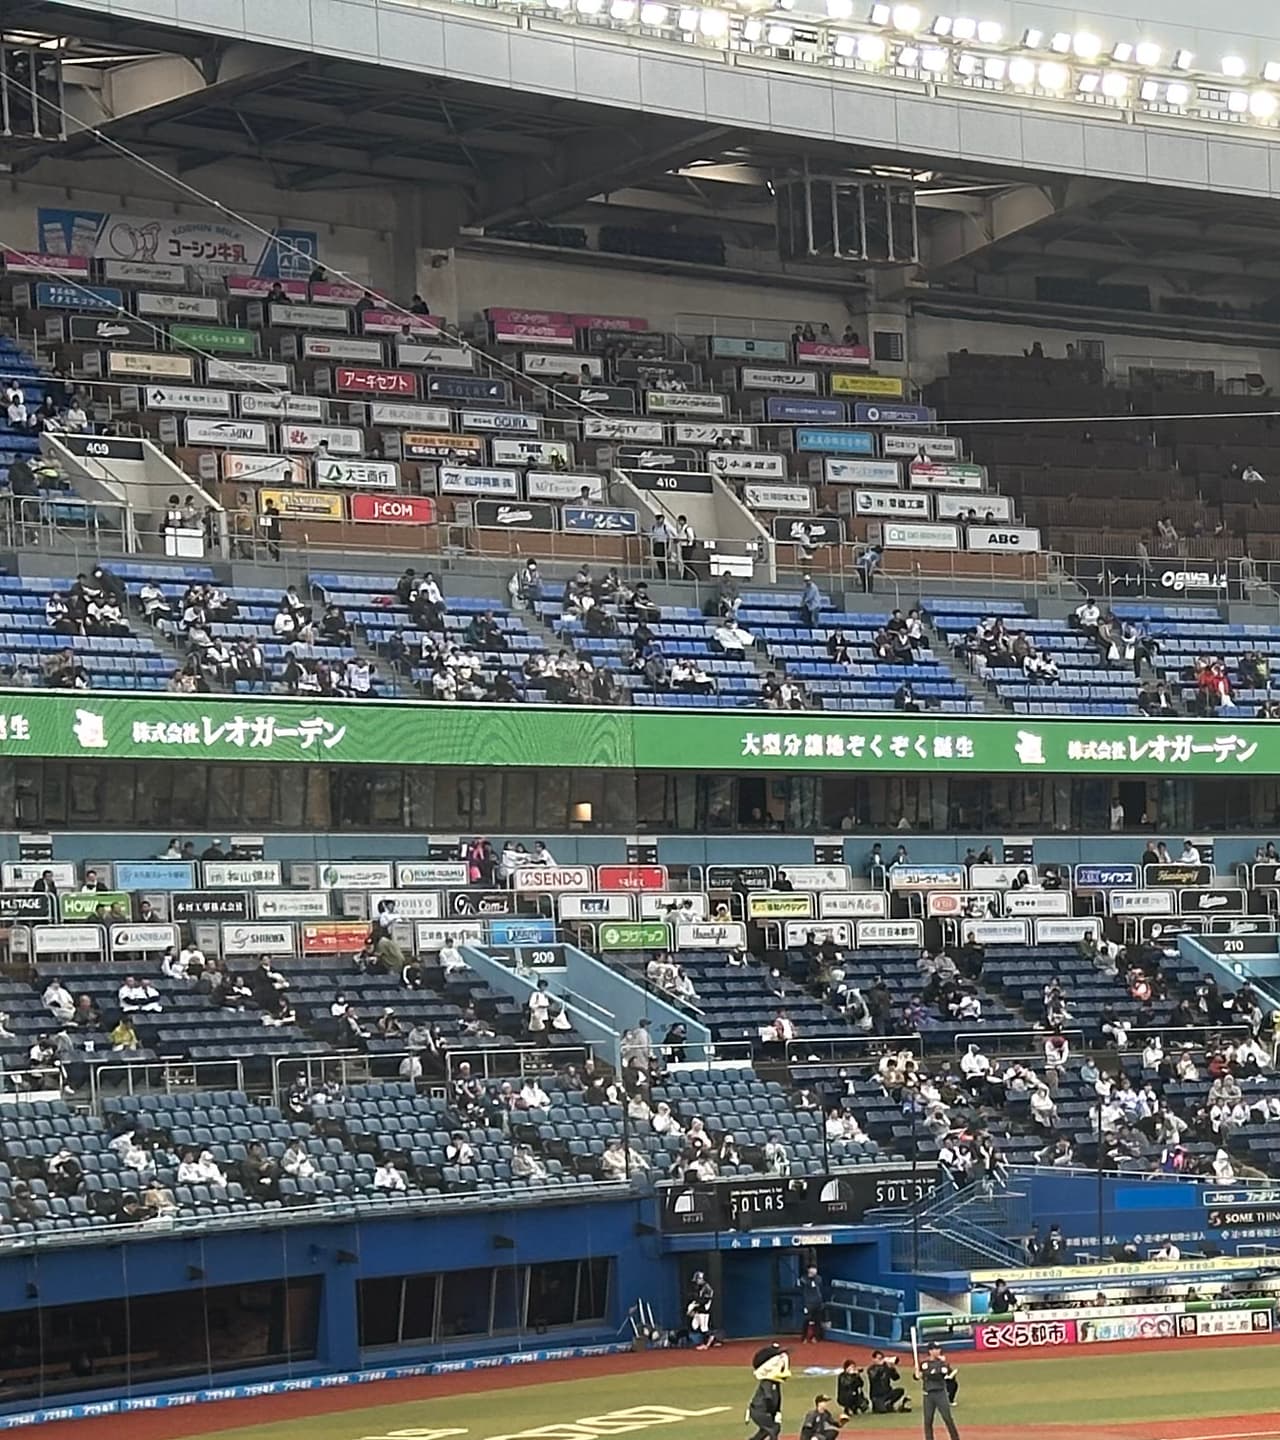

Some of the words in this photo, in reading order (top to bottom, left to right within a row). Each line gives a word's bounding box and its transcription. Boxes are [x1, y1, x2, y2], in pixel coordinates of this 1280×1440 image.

[168, 238, 247, 262] コーシン牛乳
[344, 371, 408, 389] アーキセプト
[86, 443, 109, 455] 409
[656, 477, 677, 488] 410
[373, 502, 413, 516] J:COM
[988, 534, 1020, 545] ABC
[132, 715, 346, 749] 株式会社レオガーデン
[1067, 734, 1258, 763] 株式会社レオガーデン
[536, 871, 583, 886] SENDO
[1224, 940, 1244, 951] 210
[532, 951, 555, 963] 209
[730, 1197, 785, 1214] SOLAS
[1225, 1213, 1254, 1224] SOME
[982, 1323, 1067, 1344] さくら都市
